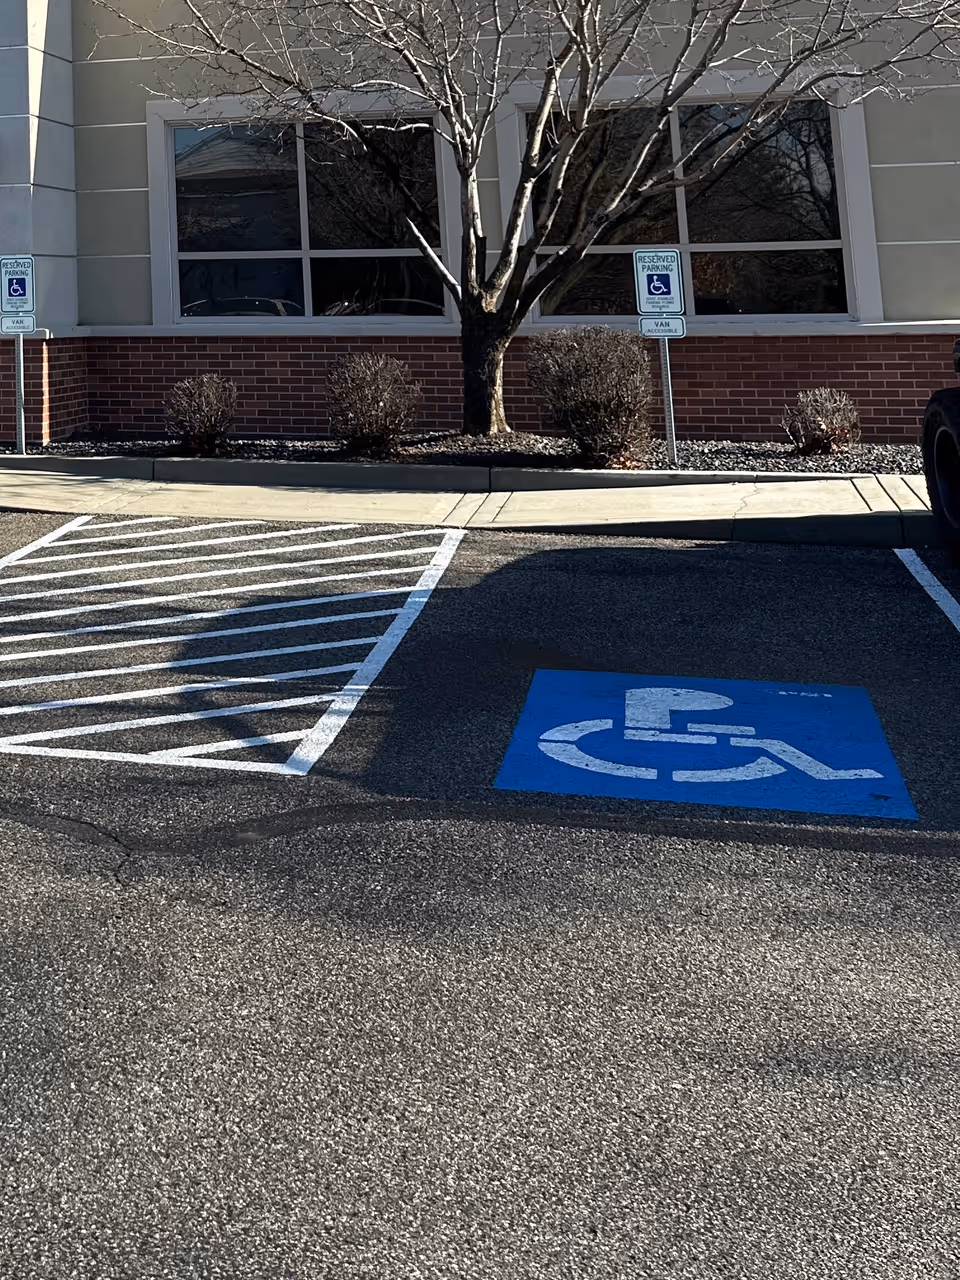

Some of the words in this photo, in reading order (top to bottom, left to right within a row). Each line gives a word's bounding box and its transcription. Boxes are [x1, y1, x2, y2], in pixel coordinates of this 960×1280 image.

[638, 255, 676, 263] RESERVED
[2, 261, 31, 269] RESERVED
[641, 264, 673, 272] PARKING
[5, 269, 29, 277] PARKING
